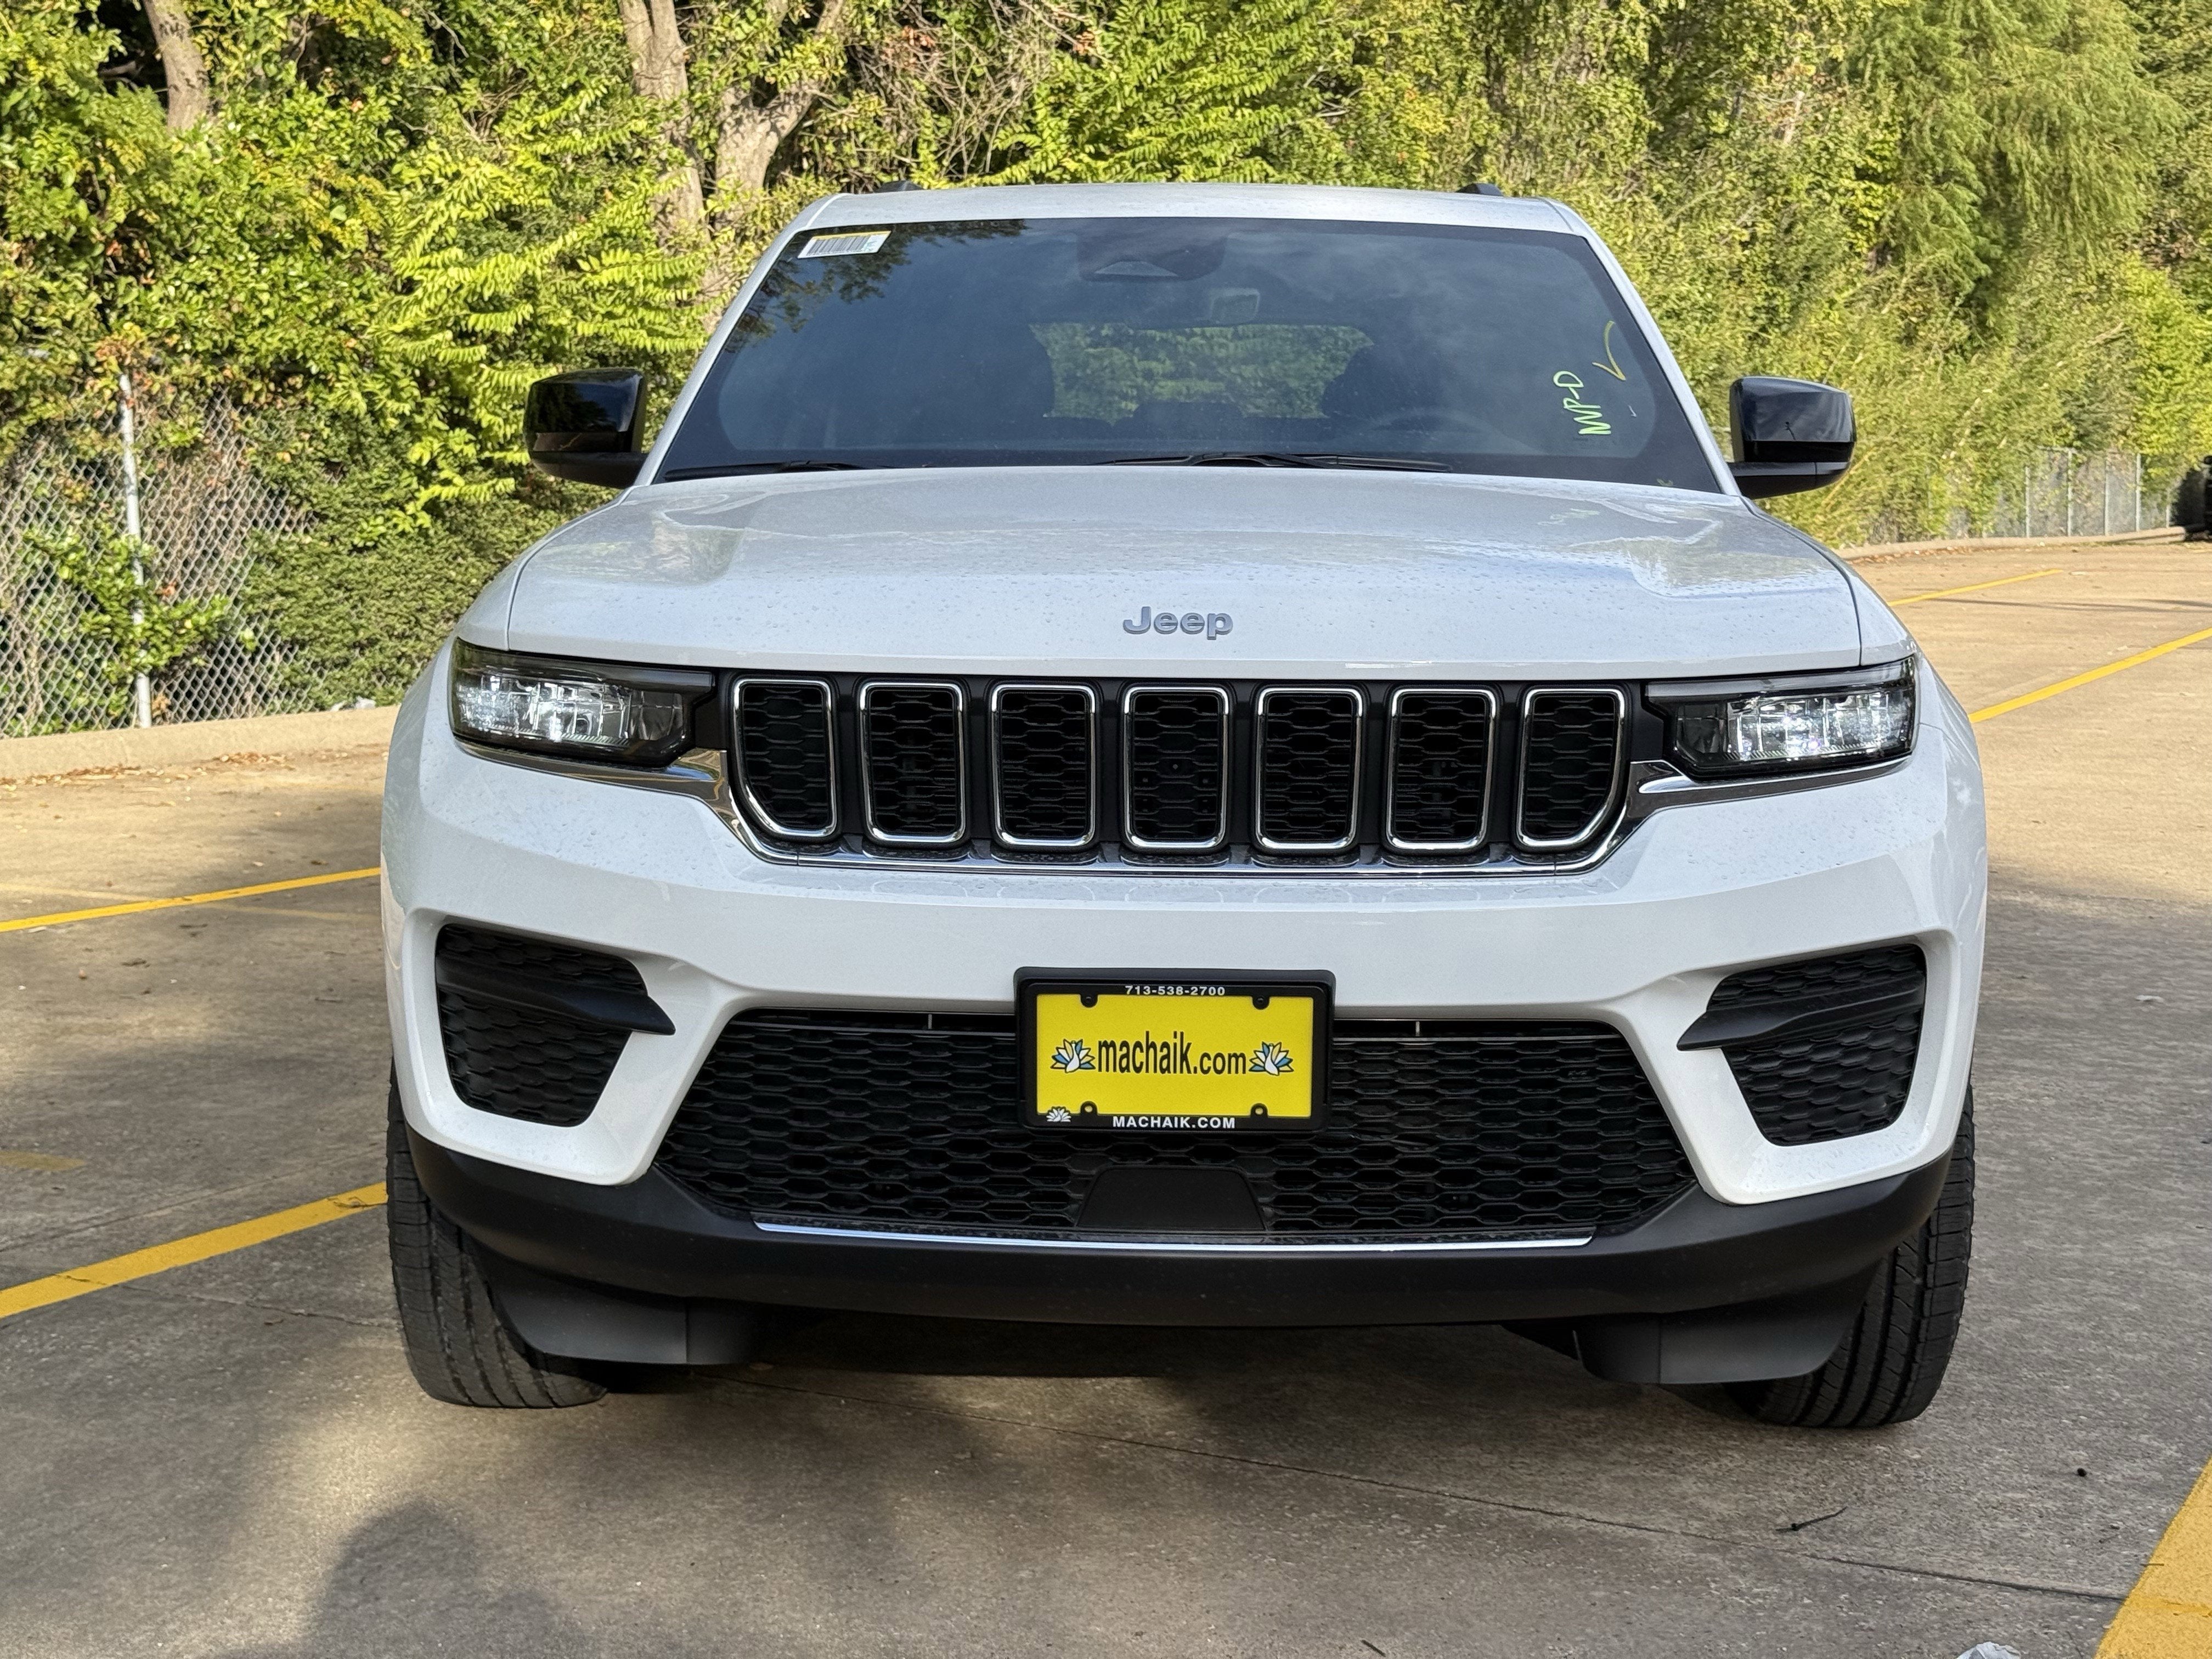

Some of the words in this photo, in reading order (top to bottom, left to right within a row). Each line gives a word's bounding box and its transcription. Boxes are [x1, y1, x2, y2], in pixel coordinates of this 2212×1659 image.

[1123, 606, 1233, 640] Jeep
[1125, 985, 1226, 996] 713-538-2700
[1098, 1031, 1247, 1075] machaik.com
[1113, 1116, 1235, 1129] MACHAIK.COM
